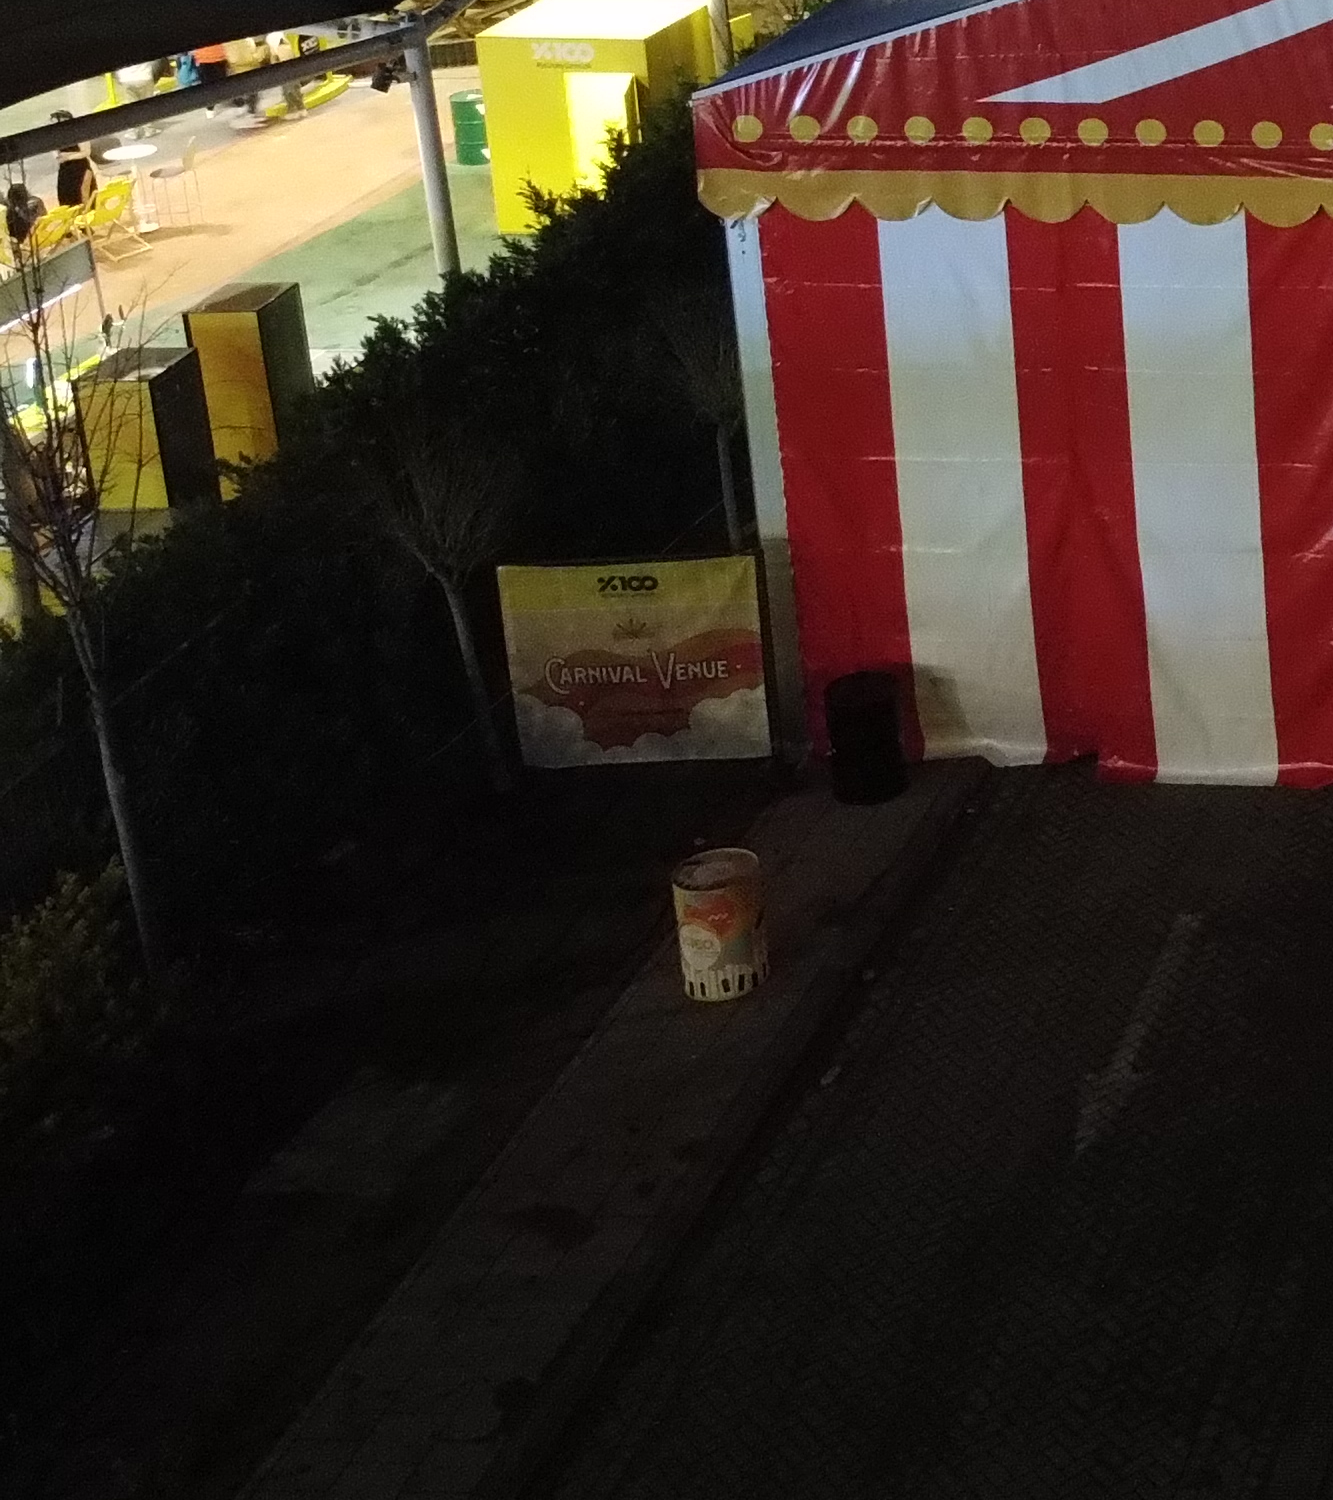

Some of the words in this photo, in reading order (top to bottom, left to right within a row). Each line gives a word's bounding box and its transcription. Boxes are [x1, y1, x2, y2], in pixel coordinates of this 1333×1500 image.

[597, 575, 659, 592] %100
[545, 657, 648, 695] CARNIVAL
[651, 652, 729, 690] VENUE
